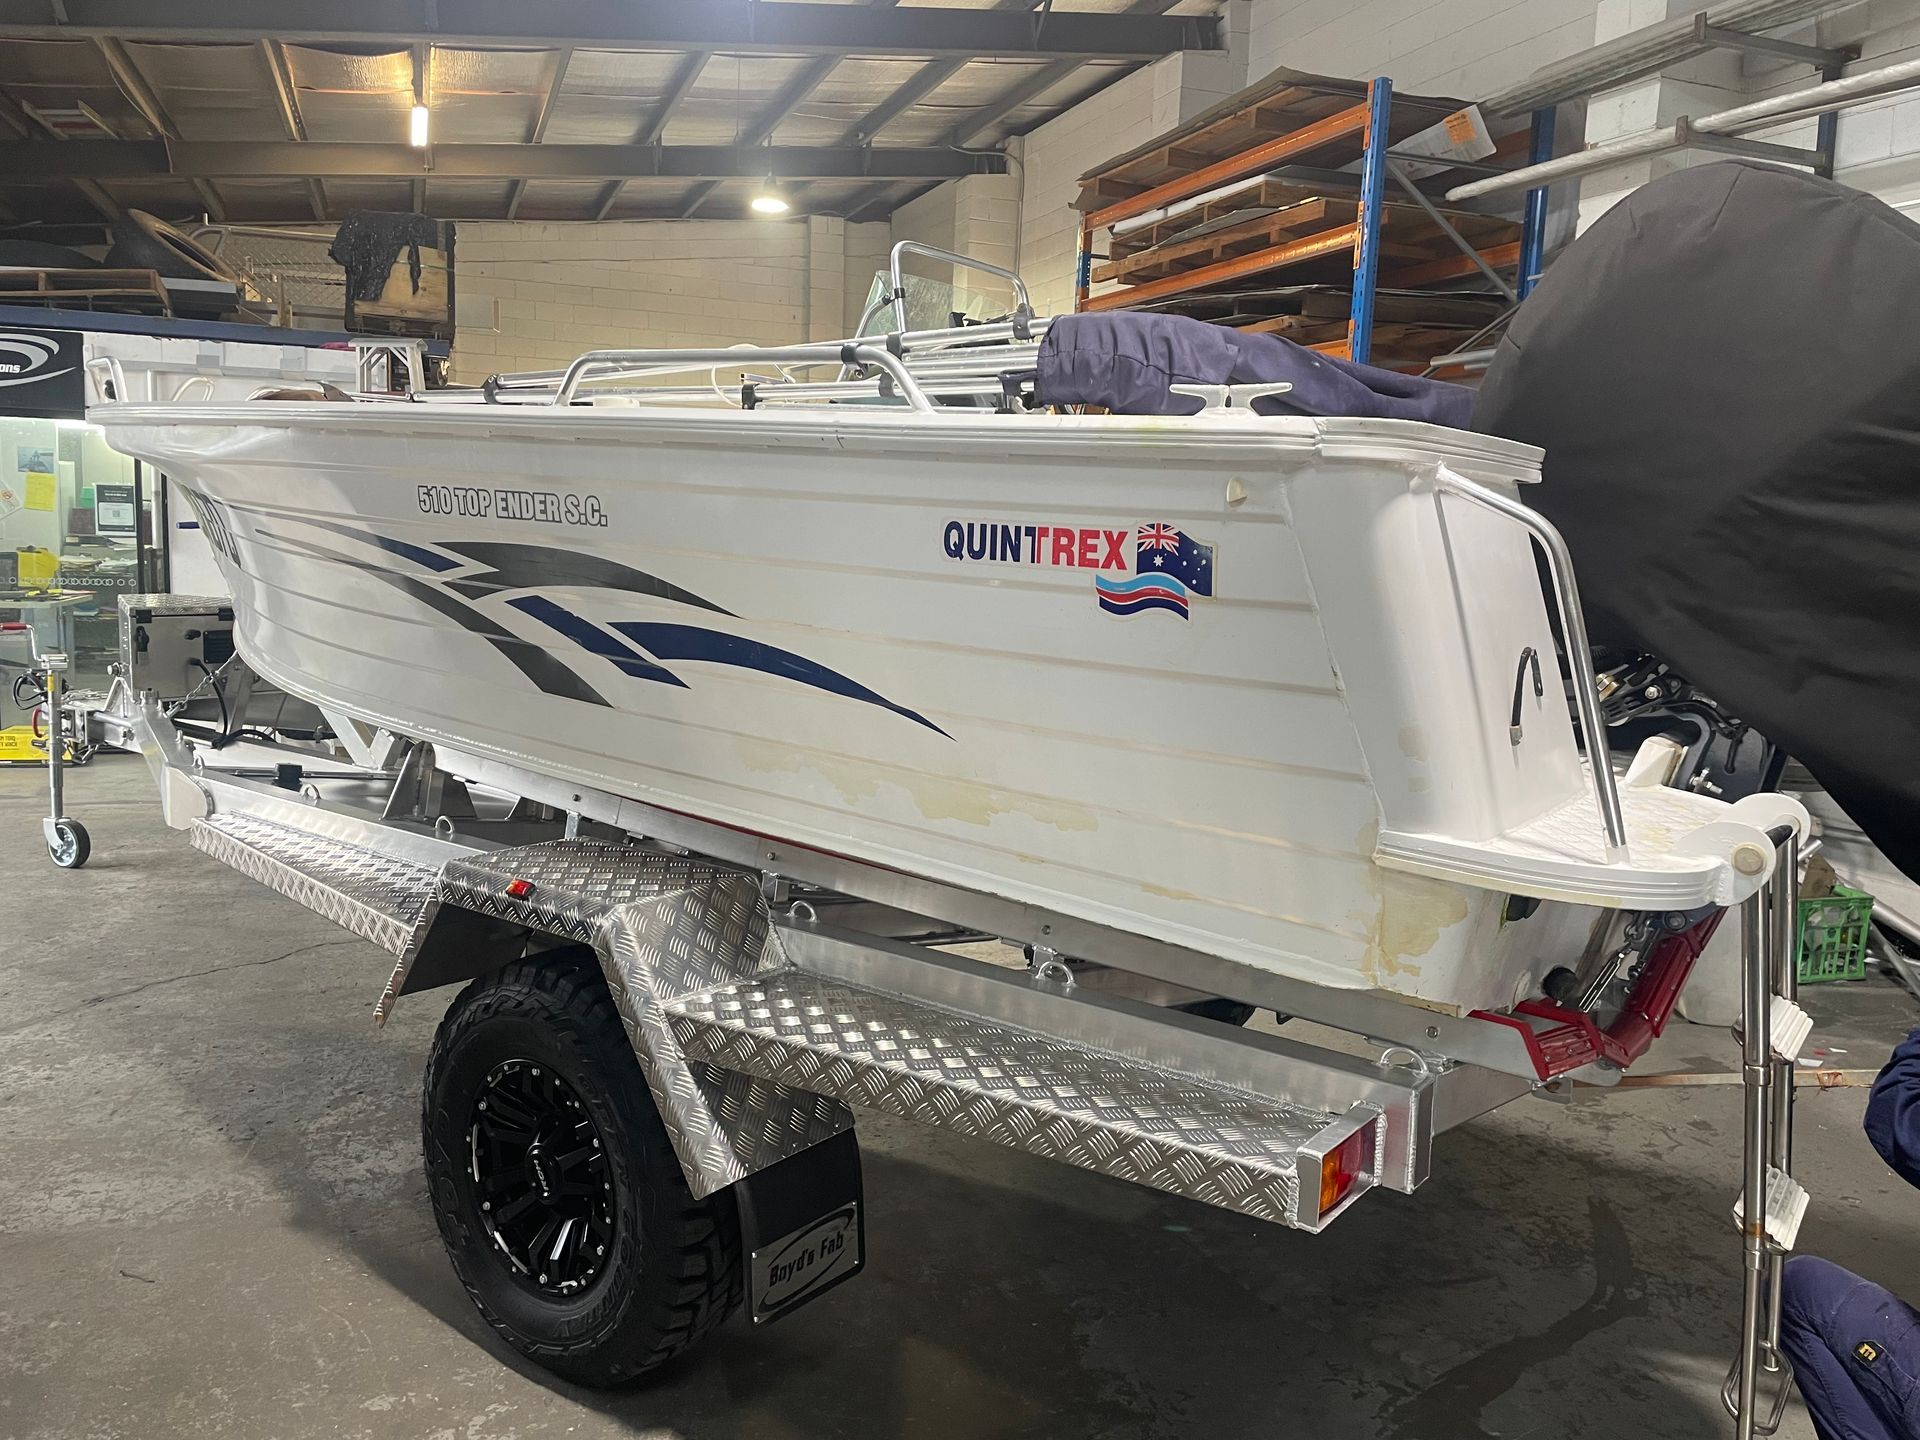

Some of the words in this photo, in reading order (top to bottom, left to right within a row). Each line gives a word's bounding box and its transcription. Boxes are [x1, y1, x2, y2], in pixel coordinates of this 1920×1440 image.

[417, 485, 452, 515] 510
[453, 487, 492, 518] TOP
[494, 489, 563, 524] ENDER
[564, 493, 609, 528] S.C.
[943, 520, 1129, 571] QUINTREX
[769, 1247, 816, 1288] Boyd's
[820, 1230, 844, 1259] Fab
